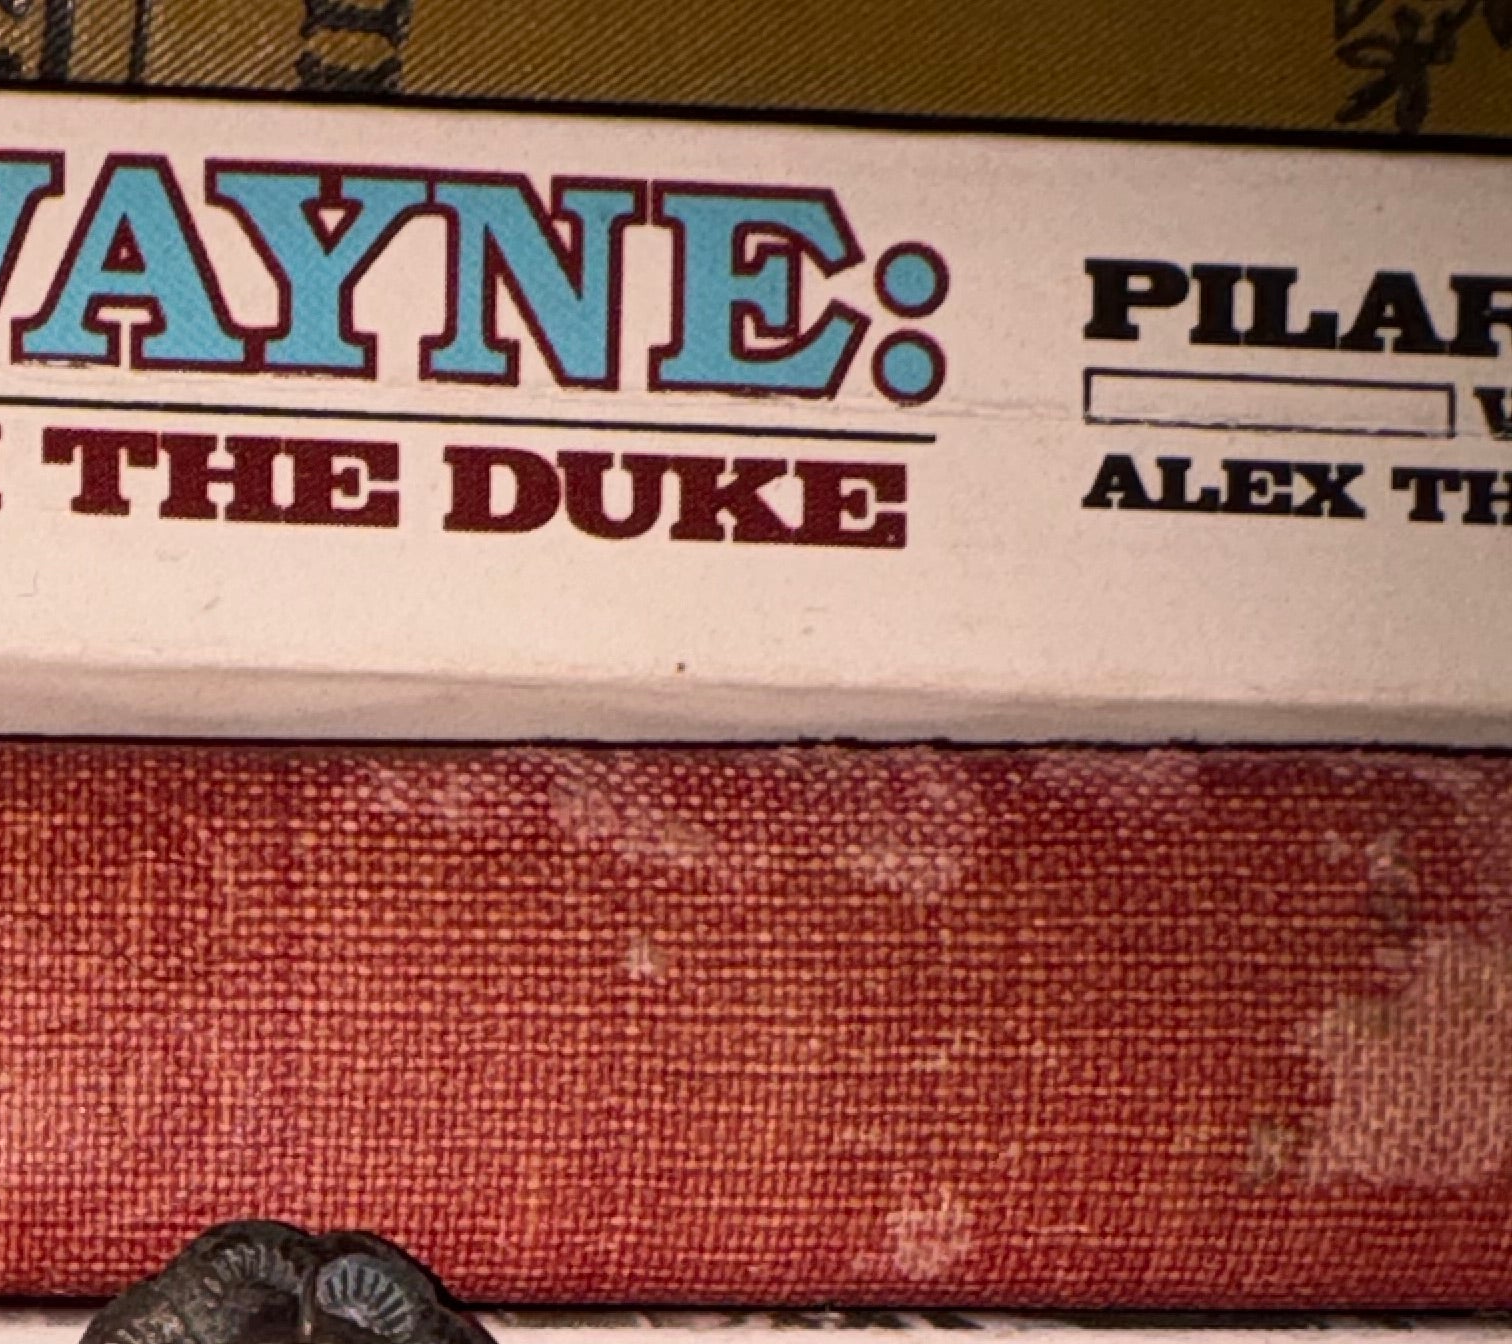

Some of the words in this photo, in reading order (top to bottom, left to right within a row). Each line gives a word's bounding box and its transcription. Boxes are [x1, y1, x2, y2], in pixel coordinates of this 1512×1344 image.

[41, 425, 399, 528] THE
[442, 444, 908, 549] DUKE
[1081, 453, 1366, 519] ALEX
